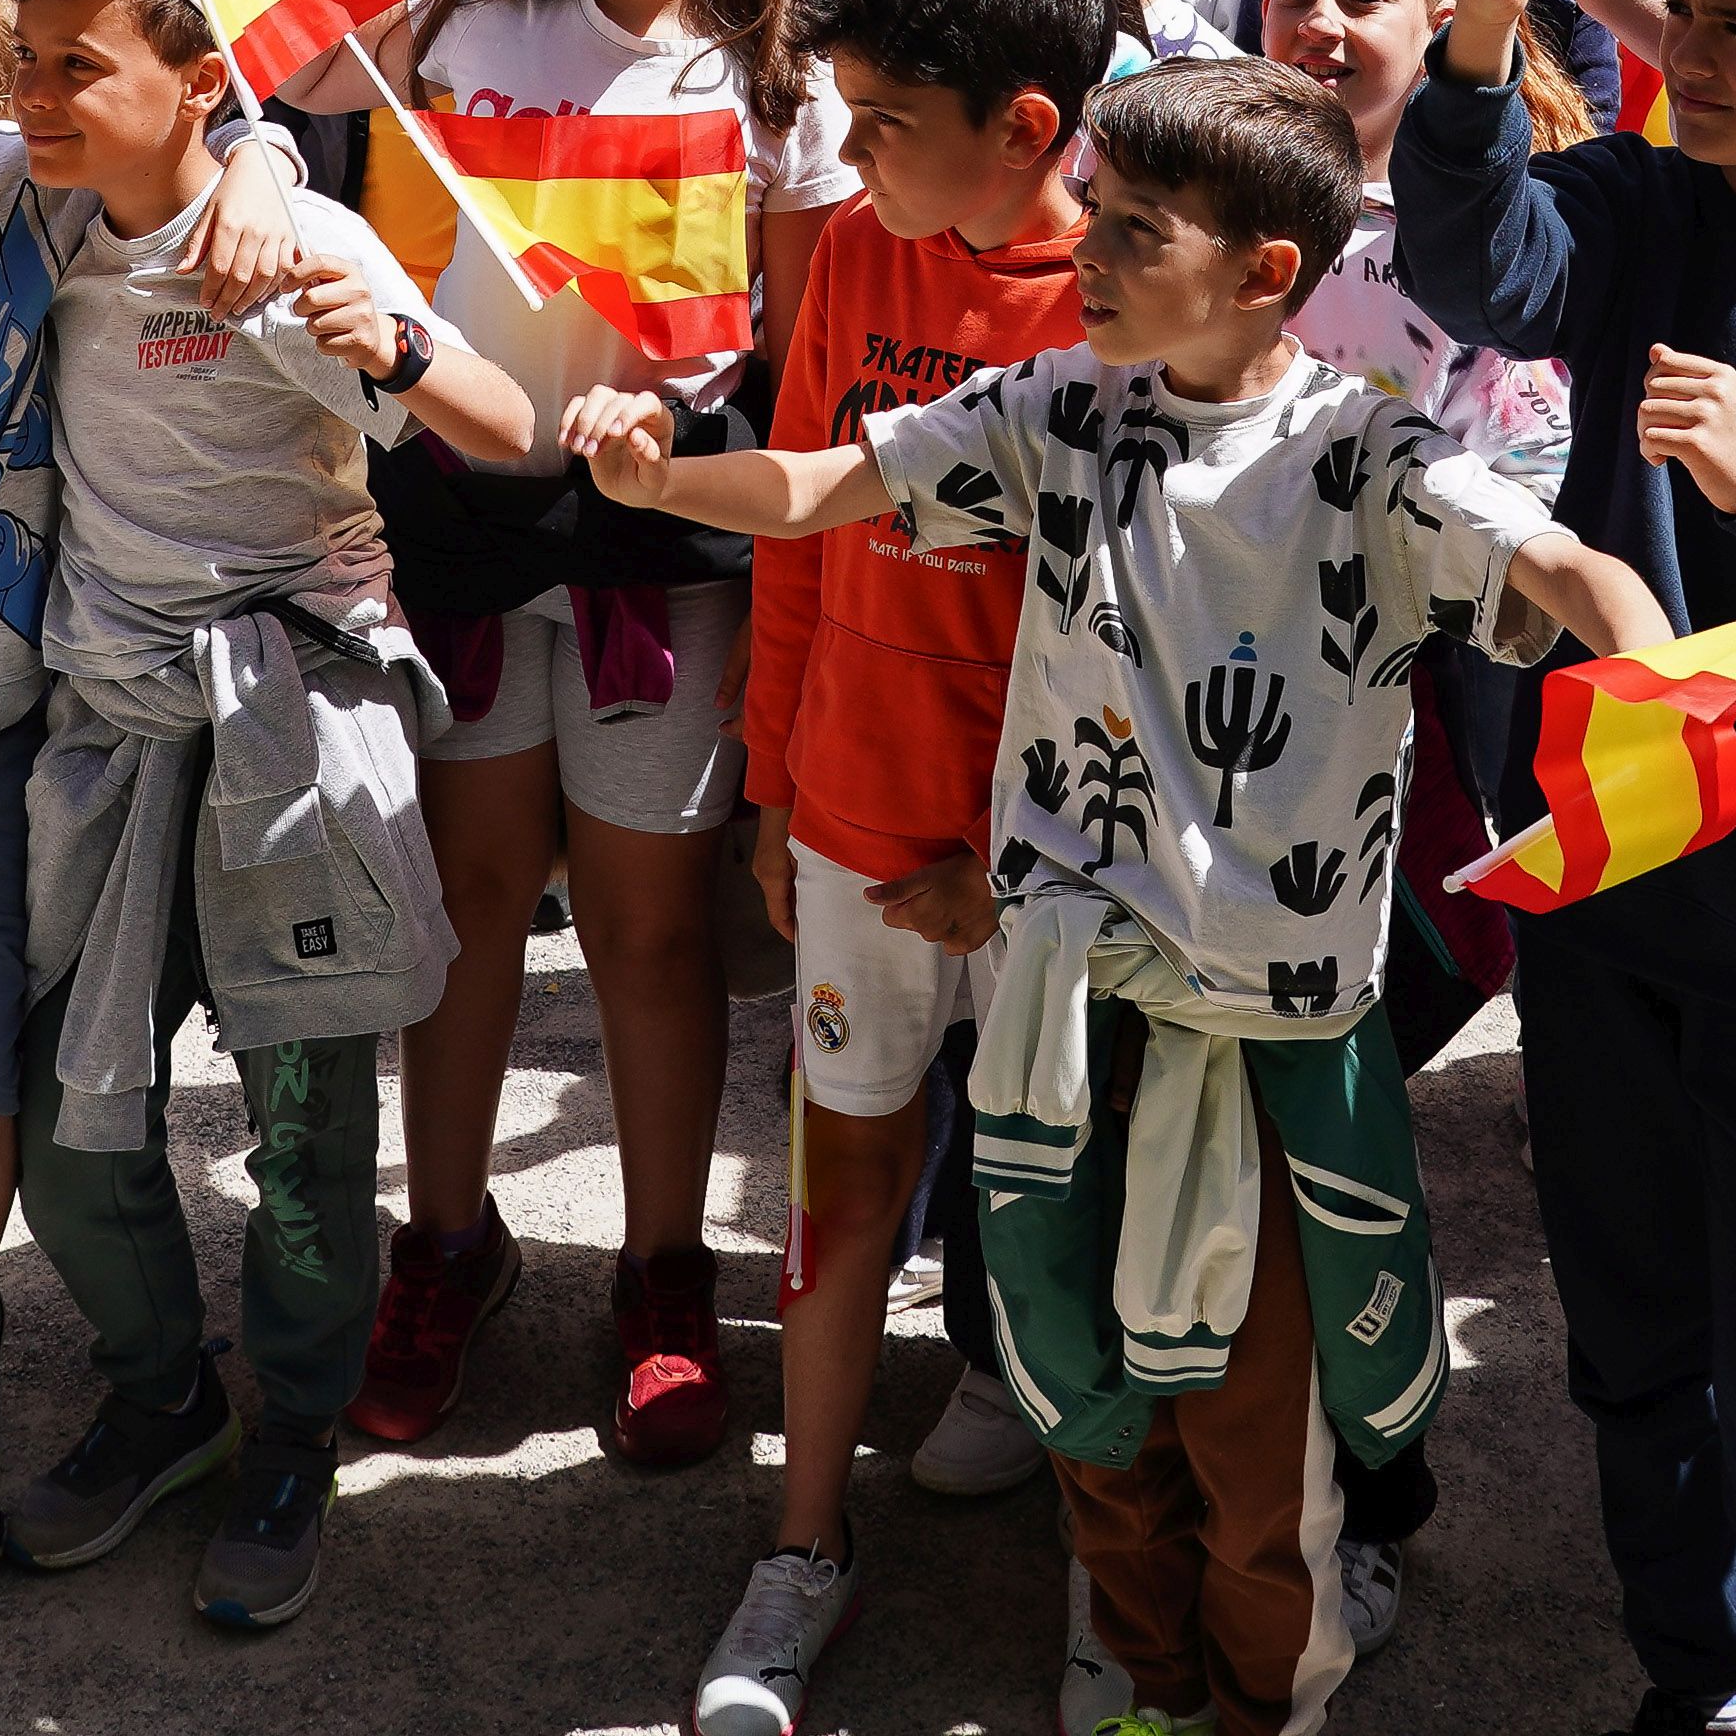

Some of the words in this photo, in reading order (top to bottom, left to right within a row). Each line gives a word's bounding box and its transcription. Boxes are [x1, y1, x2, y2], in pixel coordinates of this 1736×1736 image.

[137, 330, 236, 371] YESTERDAY
[868, 537, 899, 558] SKATE
[917, 552, 944, 569] YOU
[947, 557, 988, 576] DARE!
[302, 935, 328, 954] EASY
